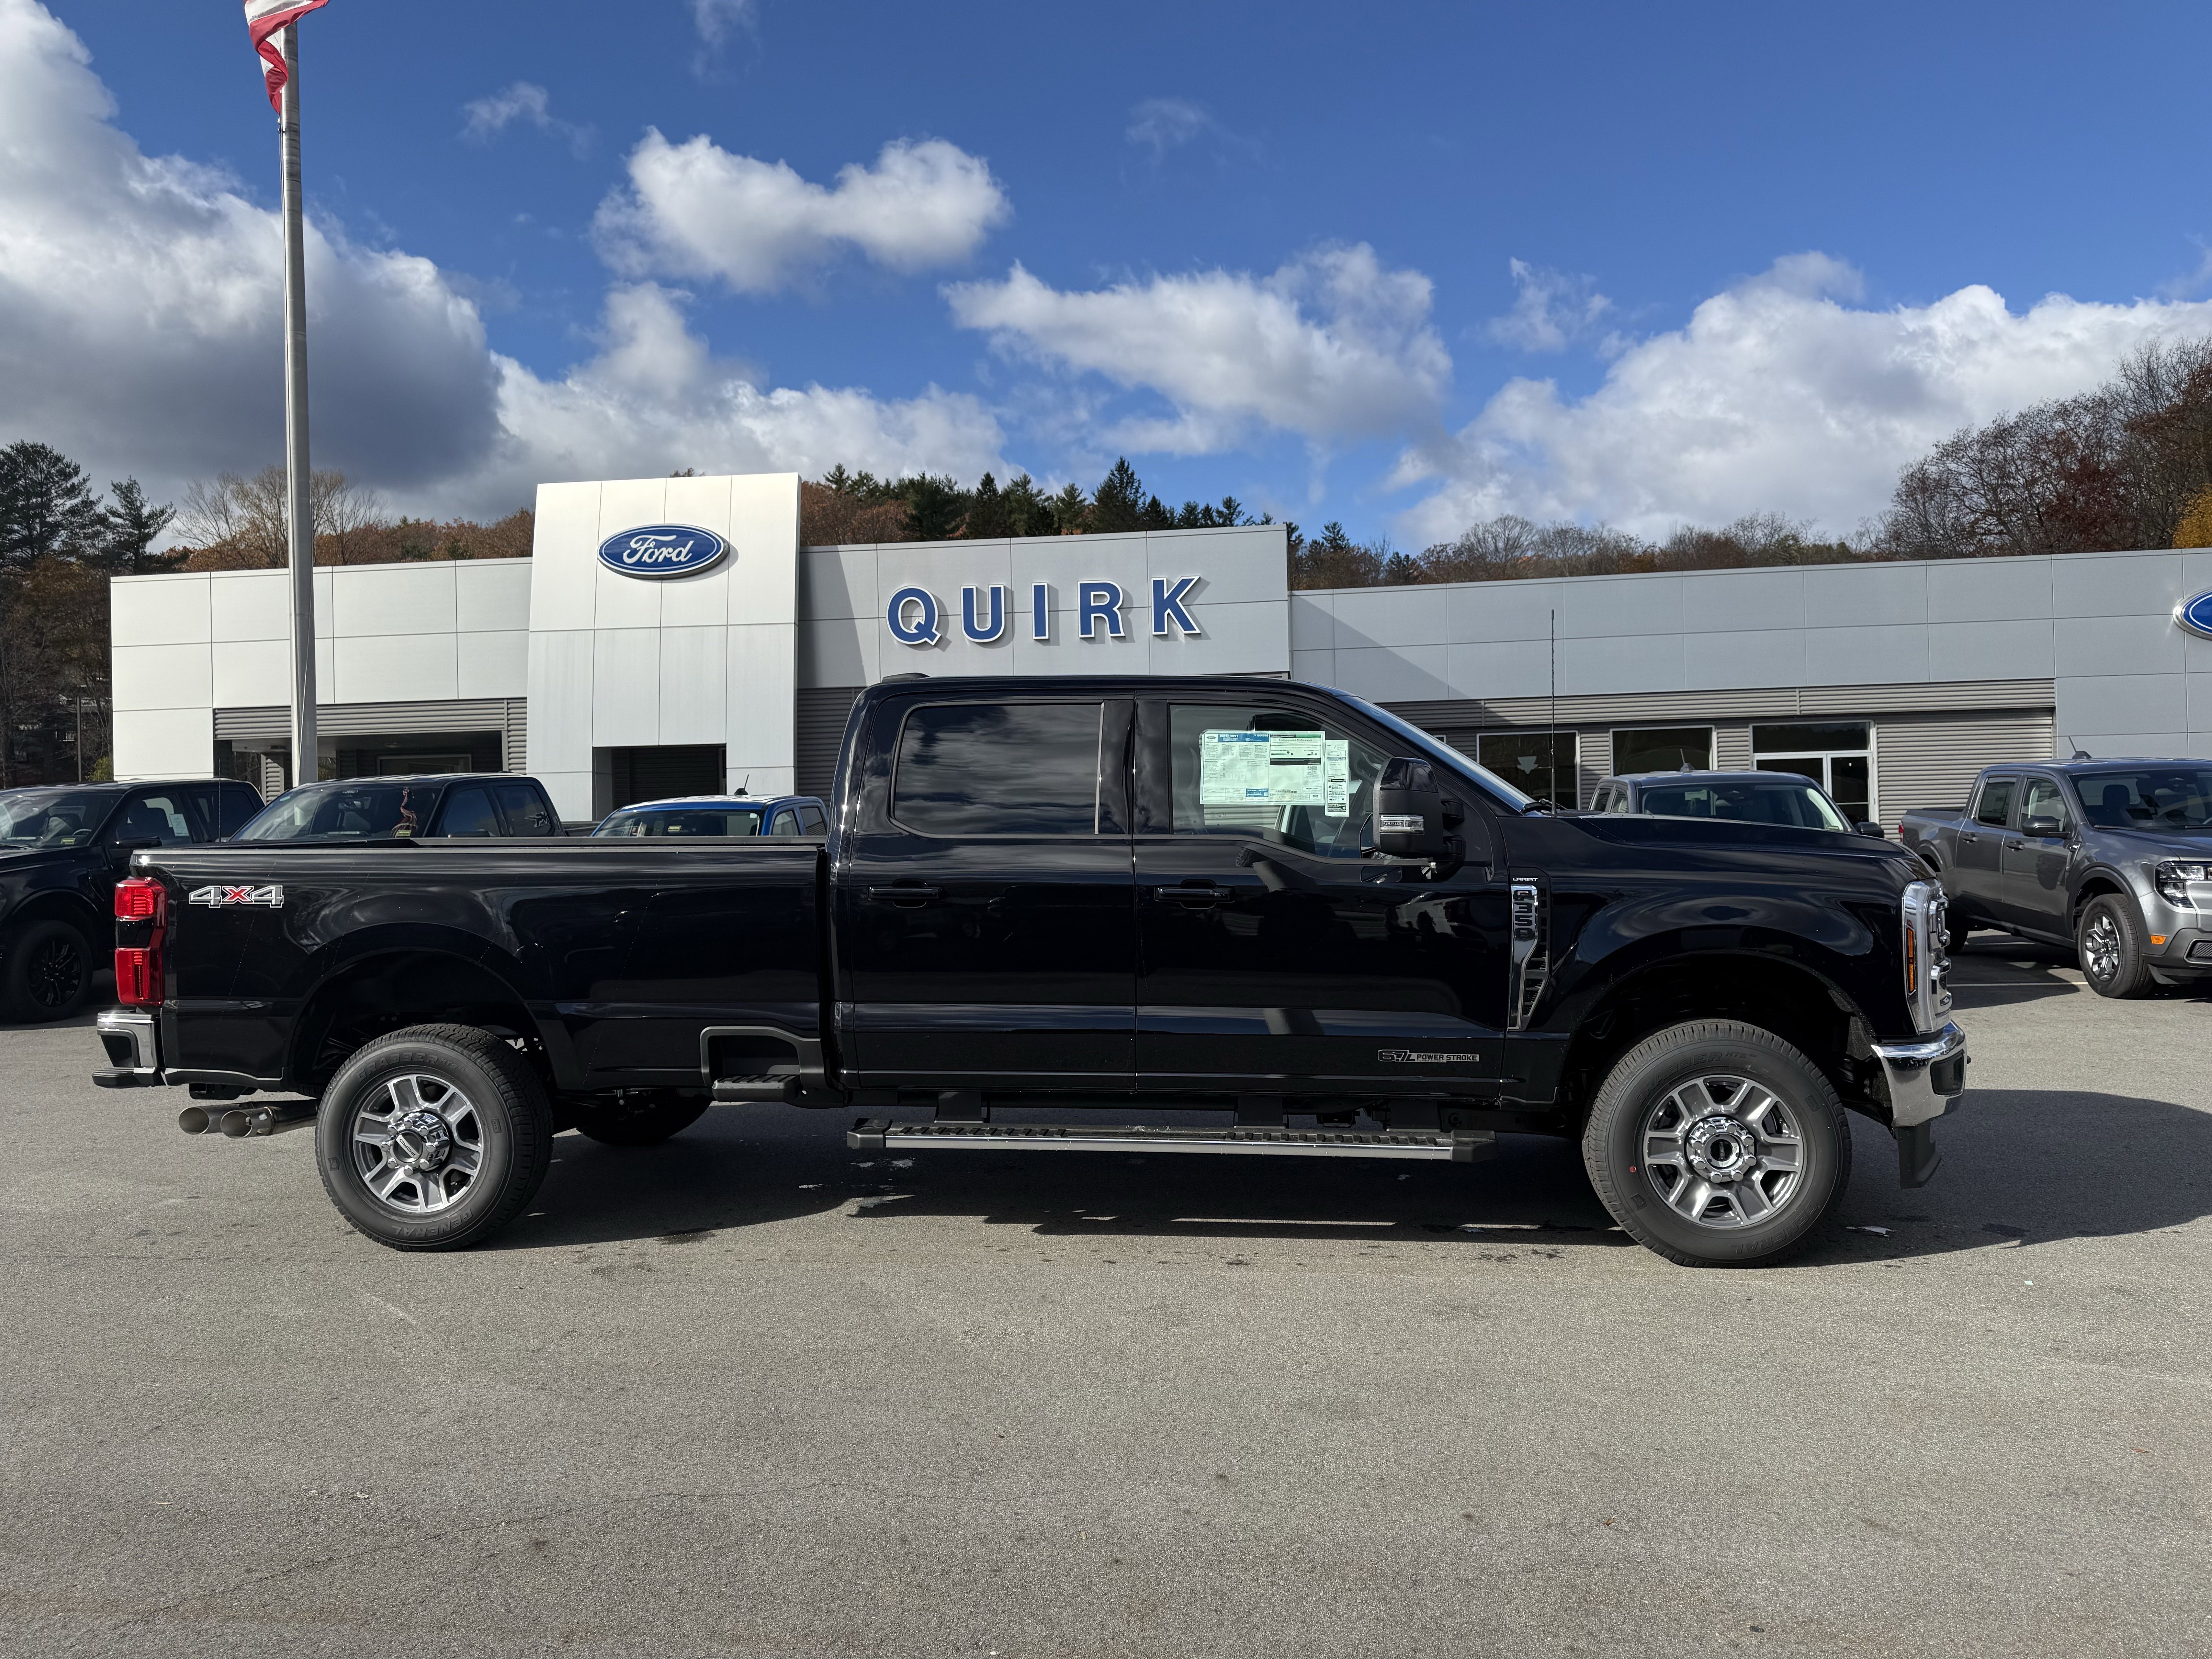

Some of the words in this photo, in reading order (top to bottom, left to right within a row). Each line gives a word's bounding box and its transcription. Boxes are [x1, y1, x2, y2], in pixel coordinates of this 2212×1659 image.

[623, 535, 694, 564] Ford
[886, 575, 1200, 646] QUIRK
[359, 1052, 439, 1083] GRABBER
[1378, 1049, 1415, 1062] 6.7L
[1635, 1051, 1723, 1108] GRABBER
[399, 1139, 416, 1156] FORD
[392, 1207, 473, 1237] GENERAL
[1729, 1199, 1819, 1254] GENERAL
